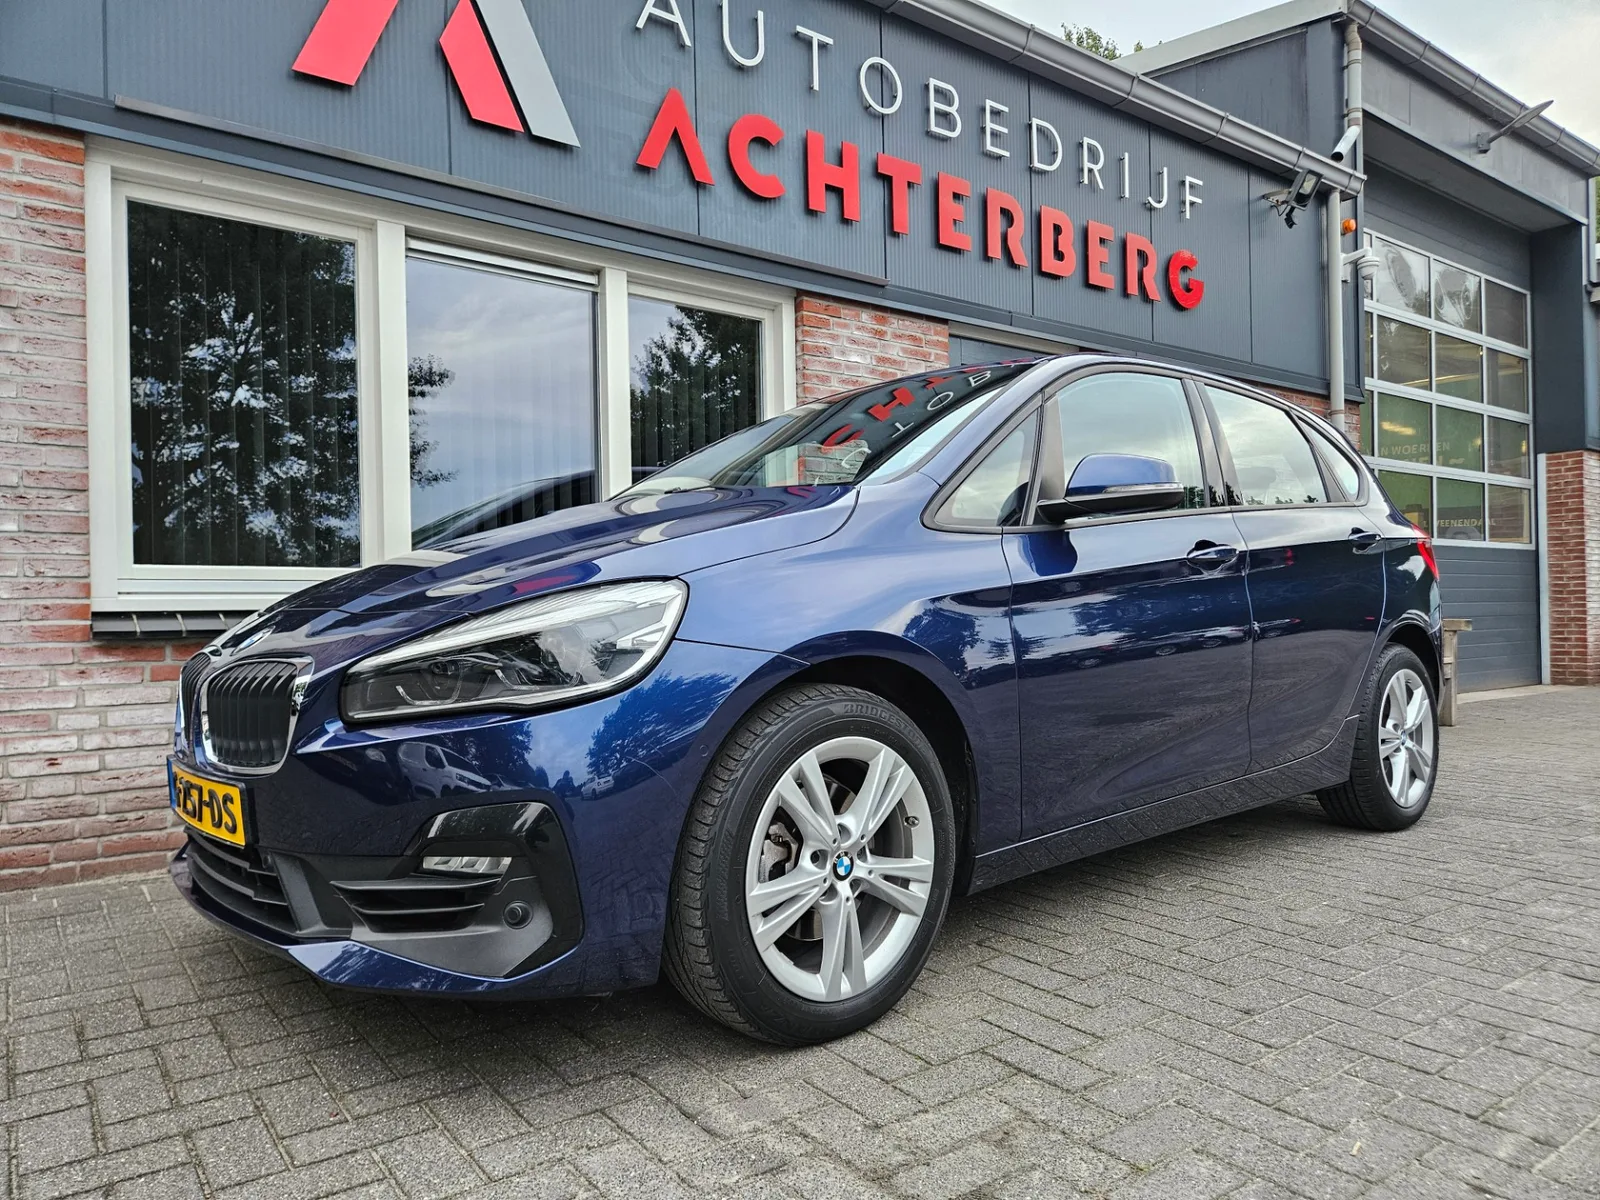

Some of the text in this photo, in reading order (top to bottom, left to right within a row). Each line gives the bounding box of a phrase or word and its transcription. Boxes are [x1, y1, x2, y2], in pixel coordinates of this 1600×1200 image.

[635, 0, 1204, 219] AUTOBEDRIJF
[636, 87, 1205, 309] ACHTERBERG
[1391, 442, 1450, 456] WOEREN
